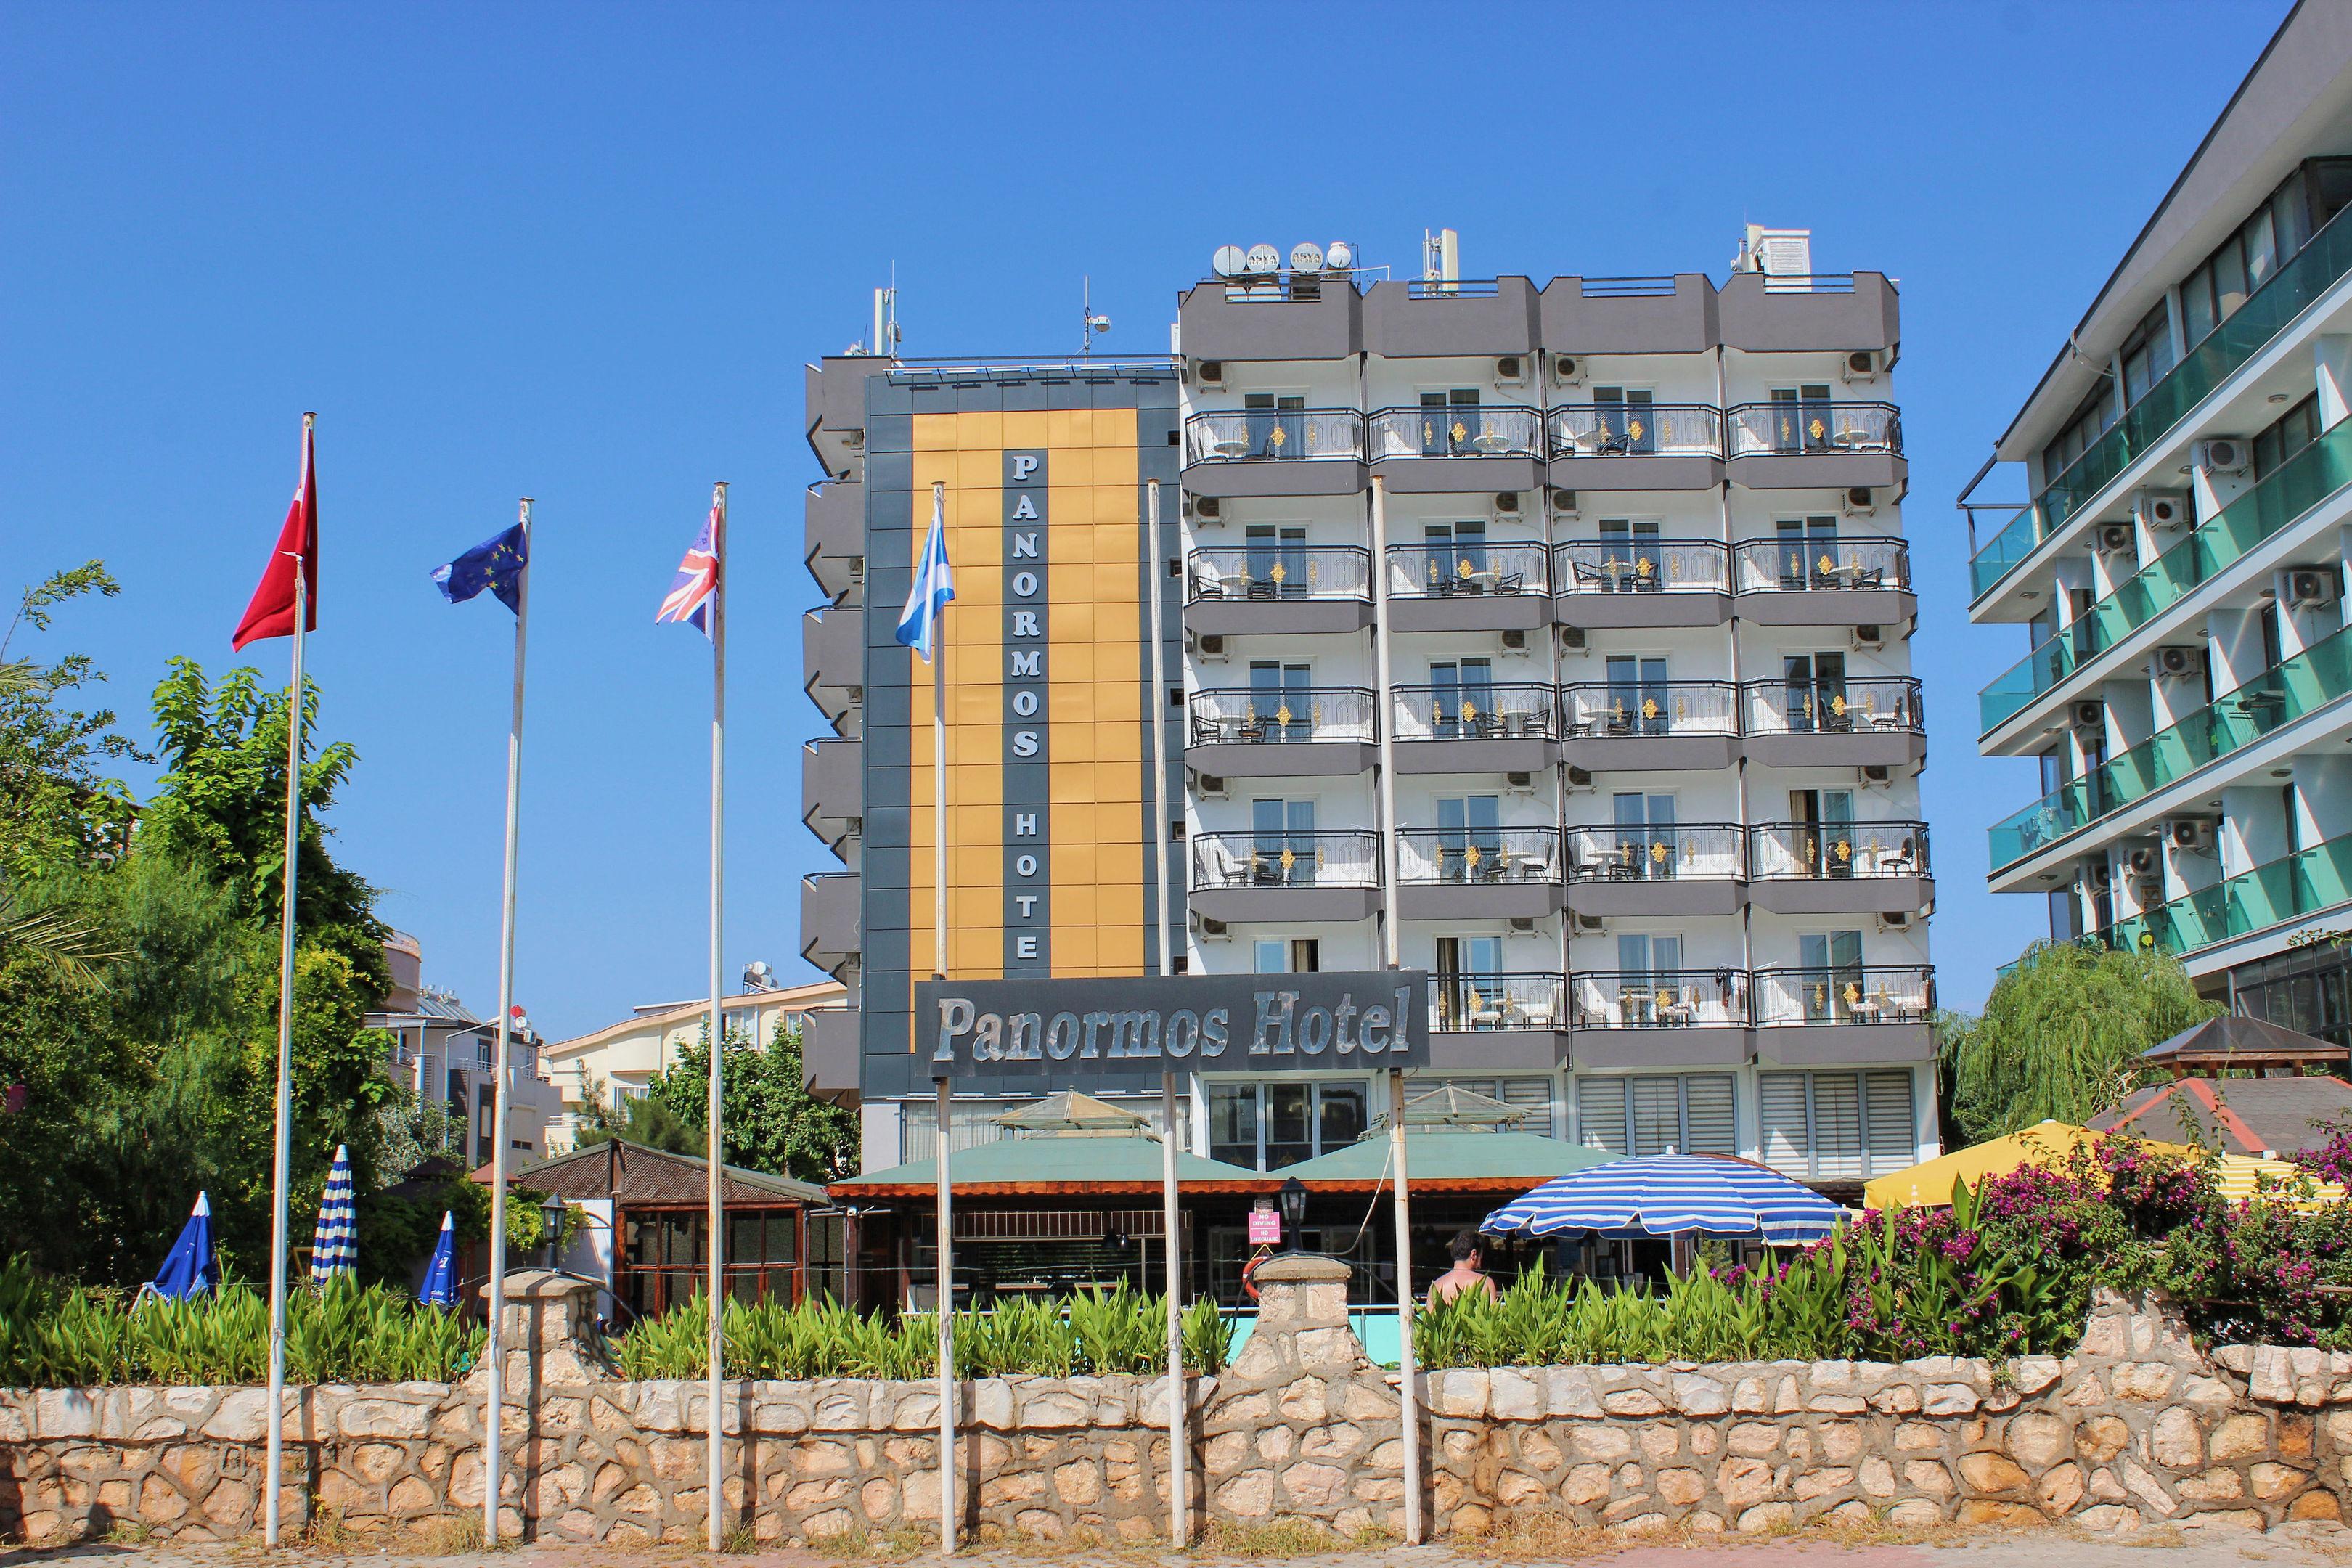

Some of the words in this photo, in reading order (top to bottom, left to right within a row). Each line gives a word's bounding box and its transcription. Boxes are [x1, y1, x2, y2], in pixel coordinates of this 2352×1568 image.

[1011, 454, 1040, 758] PANORMOS
[1016, 813, 1037, 960] HOTE
[932, 997, 1229, 1062] Panormos
[1248, 985, 1411, 1055] Hotel
